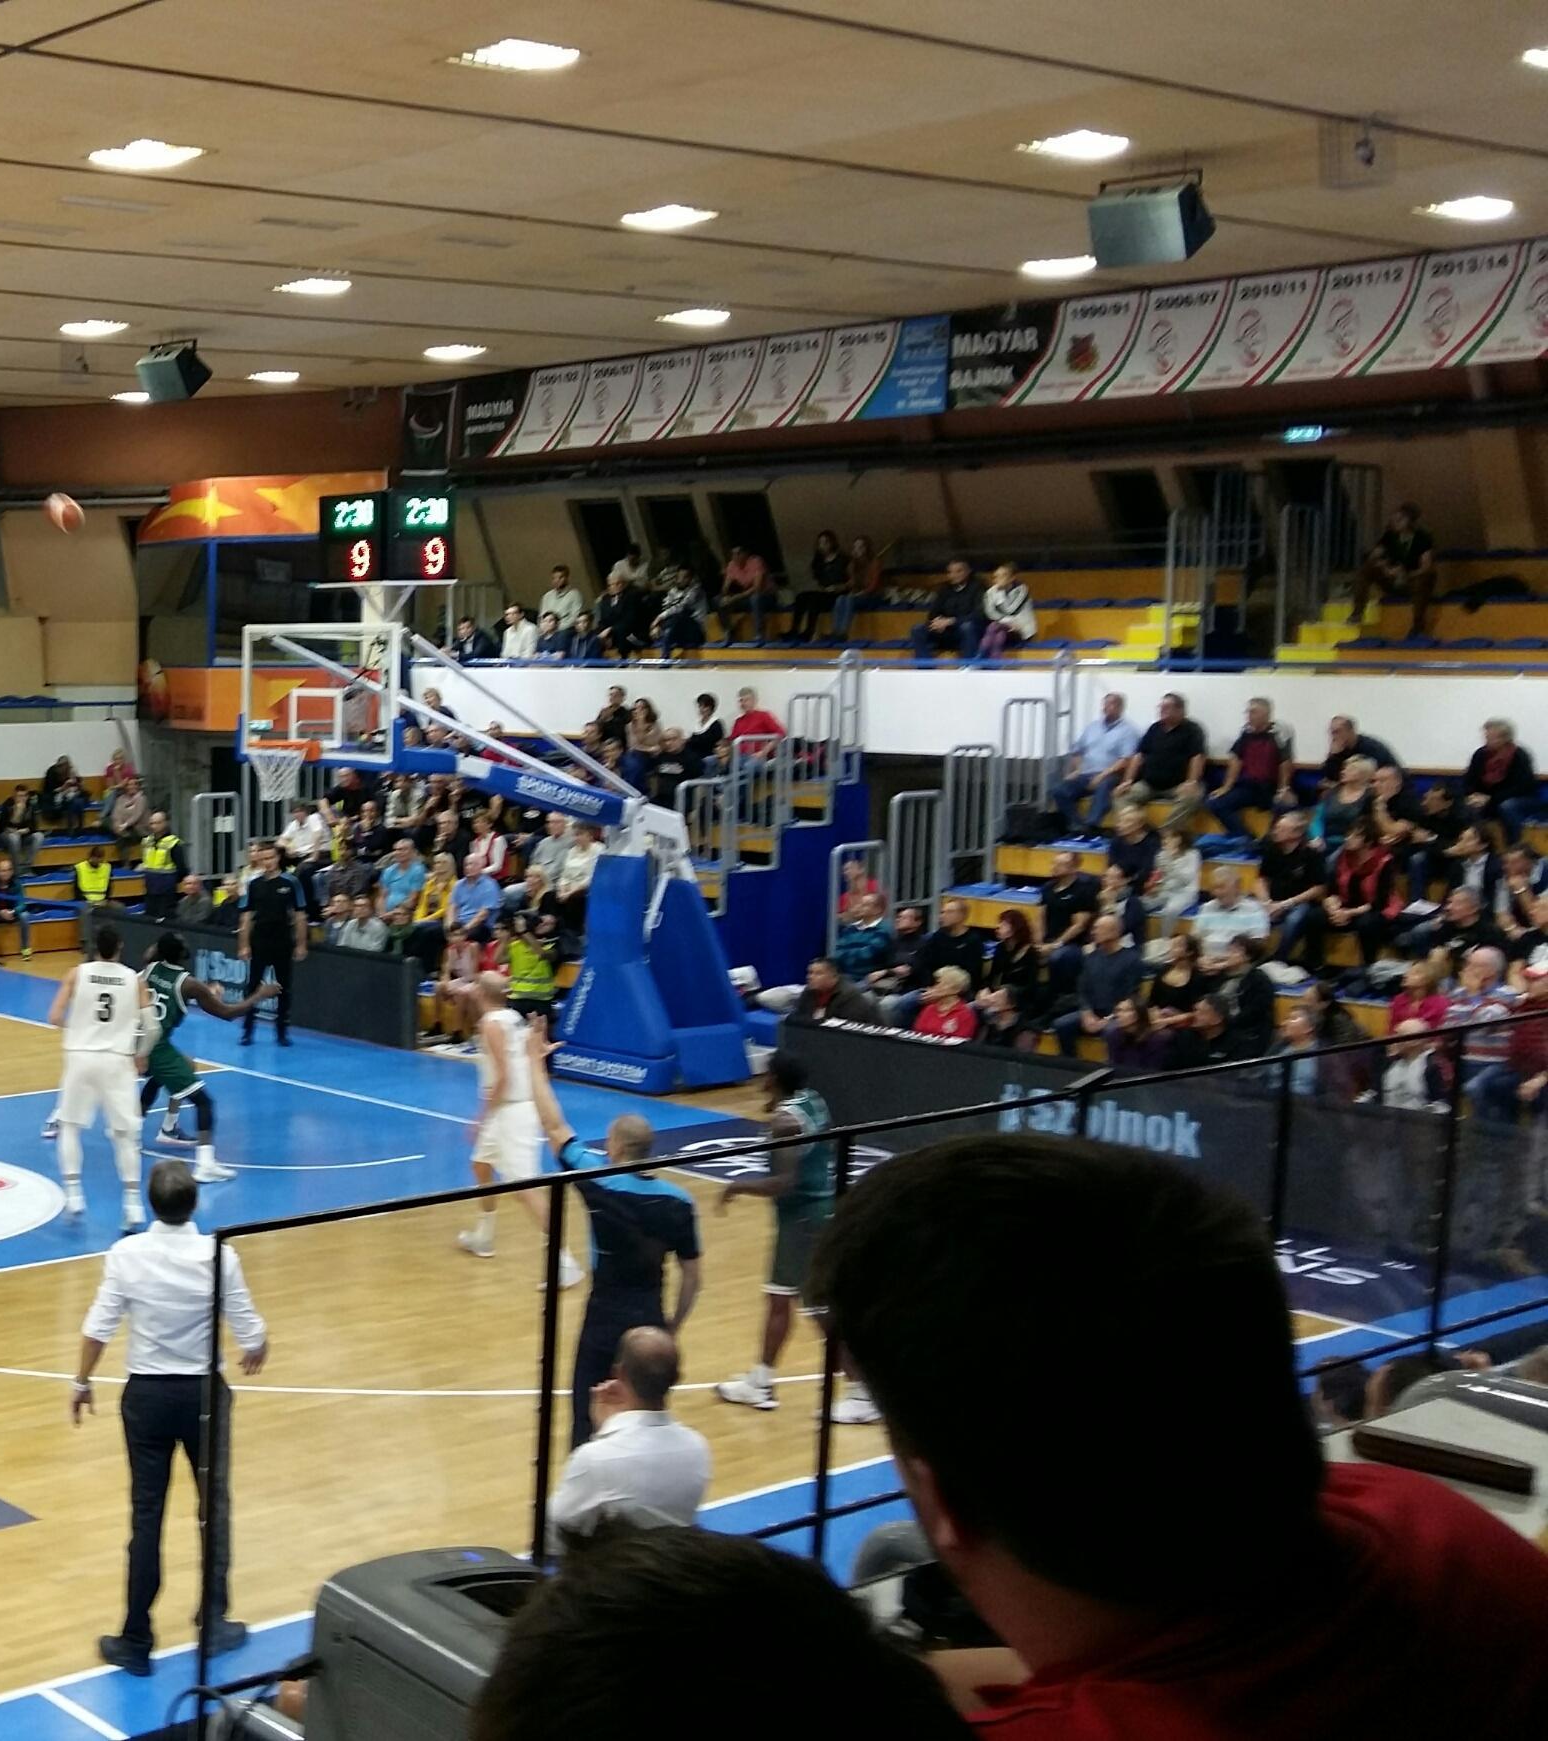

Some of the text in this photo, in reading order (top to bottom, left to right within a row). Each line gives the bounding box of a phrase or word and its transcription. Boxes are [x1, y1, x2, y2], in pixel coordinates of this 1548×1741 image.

[1331, 267, 1405, 290] 2011/12
[1430, 253, 1510, 278] 2013/14
[1238, 280, 1307, 301] 2010/11
[952, 326, 1039, 357] MAGYAR
[466, 399, 514, 421] MAGYAR
[351, 539, 371, 577] 9
[424, 537, 445, 575] 9
[96, 992, 113, 1023] 3
